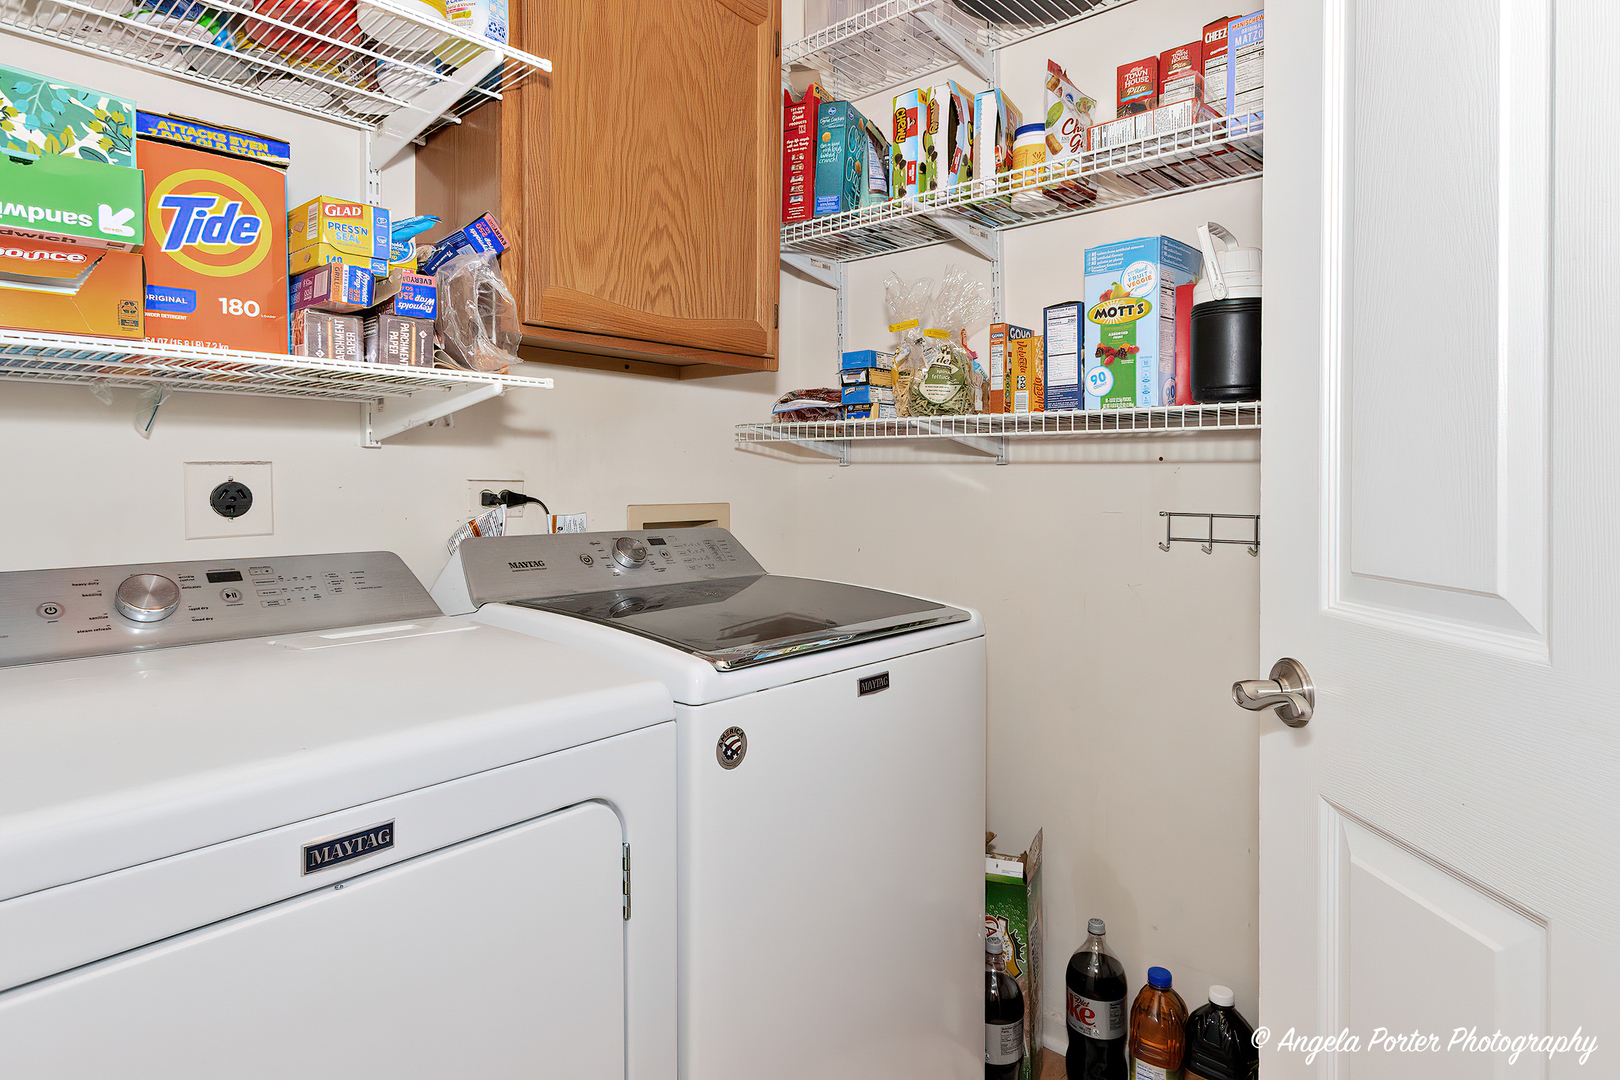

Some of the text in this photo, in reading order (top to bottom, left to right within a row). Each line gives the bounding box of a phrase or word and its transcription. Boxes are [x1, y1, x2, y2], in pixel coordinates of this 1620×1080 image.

[1204, 27, 1228, 44] CHEEZ
[1124, 68, 1149, 81] TOWN
[1124, 75, 1150, 89] HOUSE
[156, 120, 269, 153] ATTACKS EVEN
[324, 204, 362, 217] GLAD
[157, 194, 262, 253] Tide
[335, 231, 362, 244] SEAL
[0, 247, 87, 264] ounce
[402, 276, 433, 286] EVERYDA
[1126, 274, 1153, 288] VEGGIE
[145, 293, 187, 305] RIGINAL
[218, 297, 260, 318] 180
[397, 301, 434, 314] Reynolds
[414, 294, 435, 307] Wrap
[334, 318, 346, 361] ARCHMENT
[346, 331, 356, 356] PAPER
[389, 330, 399, 355] PAPER
[1016, 341, 1028, 374] Velveeta
[1090, 371, 1107, 386] 90
[507, 559, 546, 569] MAYTAG
[860, 675, 889, 693] MAYTAG
[718, 727, 745, 749] AMERICA
[309, 828, 391, 867] MAYTAG
